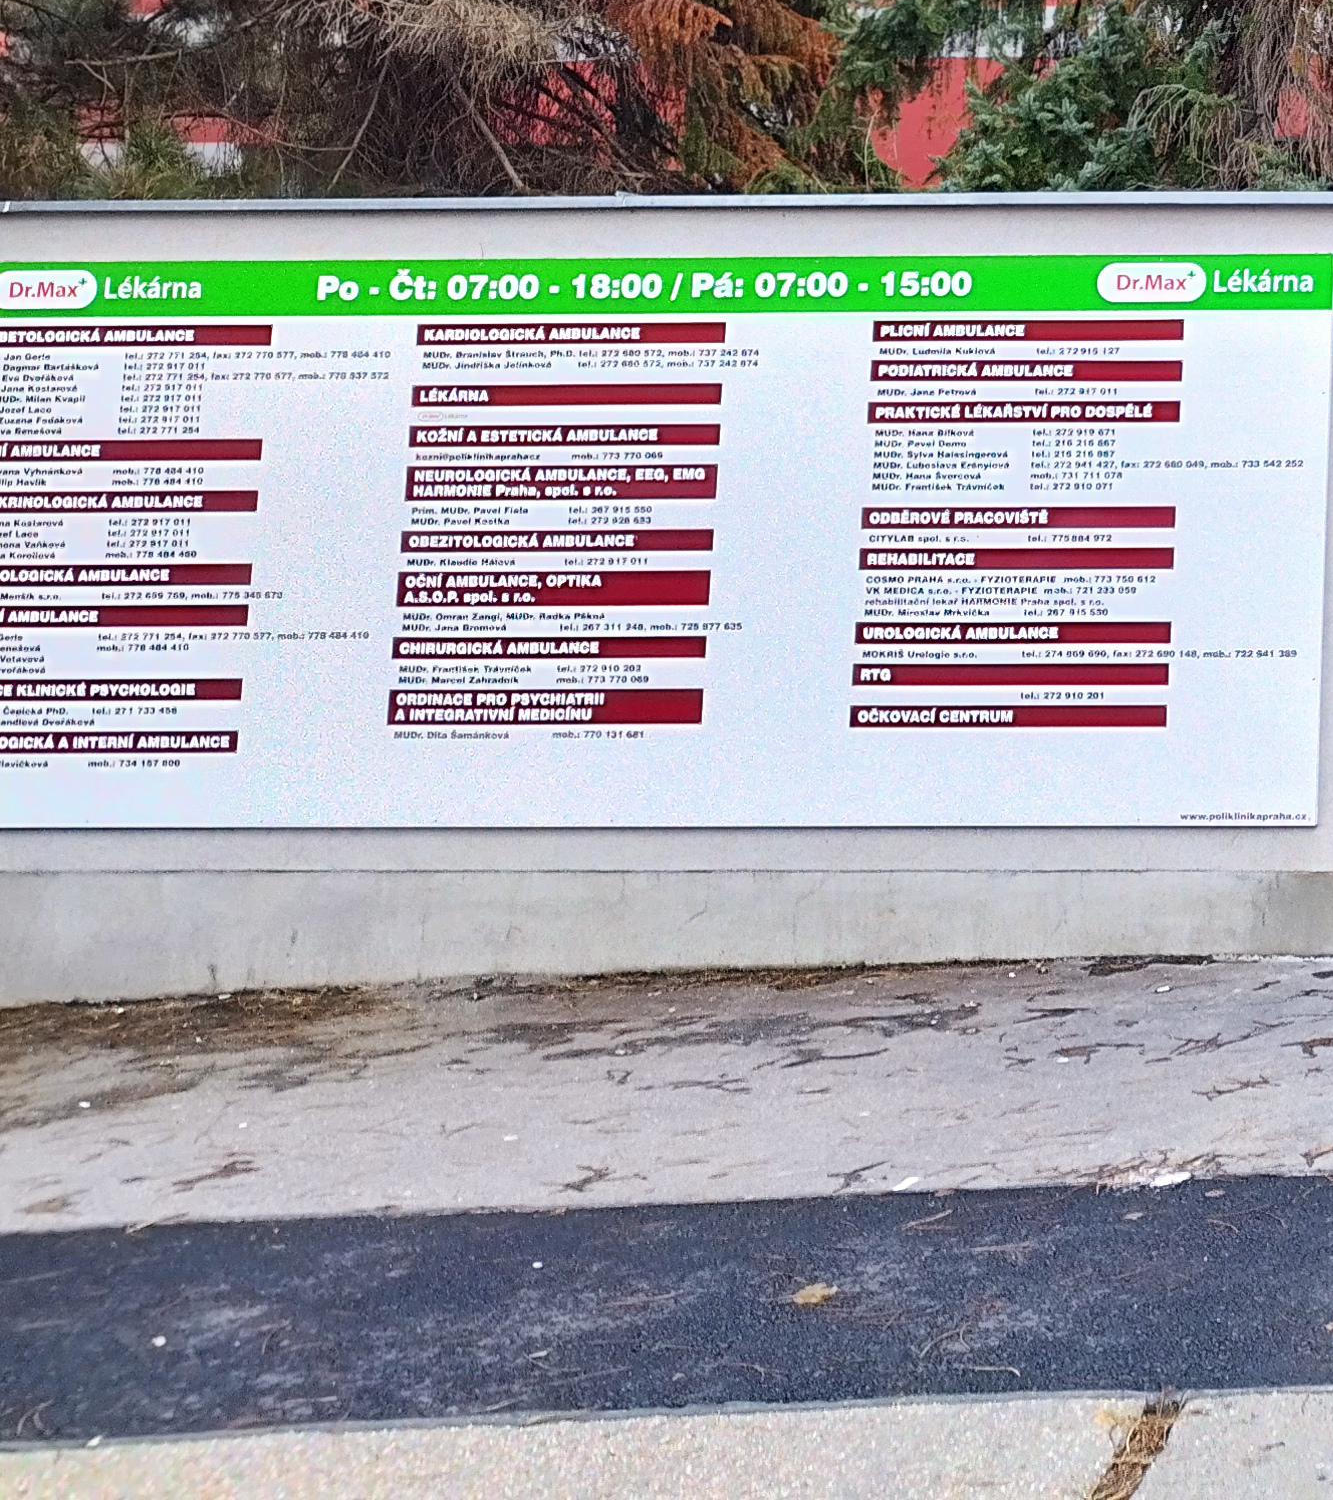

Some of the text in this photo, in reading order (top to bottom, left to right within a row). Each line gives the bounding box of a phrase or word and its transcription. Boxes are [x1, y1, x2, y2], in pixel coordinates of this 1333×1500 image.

[104, 277, 201, 300] Lékárna
[317, 275, 359, 301] Po
[389, 269, 436, 300] Čt:
[447, 274, 539, 300] 07:00
[571, 274, 662, 299] 18:00
[691, 273, 744, 299] Pá:
[755, 271, 848, 297] 07:00
[881, 271, 972, 297] 15:00
[1213, 269, 1315, 294] Lékárna
[104, 329, 195, 342] AMBULANCE
[424, 326, 640, 341] KARDIOLOGICKÁ AMBULANCE
[880, 323, 1025, 338] PLICNÍ AMBULANCE
[878, 362, 1075, 377] PODIATRICKÁ AMBULANCE
[420, 387, 489, 403] LÉKÁRNA
[875, 402, 1153, 420] PRAKTICKÉ LÉKAŘSTVÍ PRO DOSPĚLÉ
[416, 427, 658, 443] KOŽNÍ A ESTETICKÁ AMBULANCE
[11, 444, 101, 457] AMBULANCE
[414, 467, 705, 483] NEUROLOGICKÁ AMBULANCE, EEG, EMG
[413, 484, 492, 497] HARMONIE
[112, 496, 203, 508] AMBULANCE
[869, 509, 1049, 525] ODBĚROVÉ PRACOVIŠTĚ
[409, 533, 635, 549] OBEZITOLOGICKÁ AMBULANCE
[867, 553, 976, 566] REHABILITACE
[78, 569, 170, 582] AMBULANCE
[405, 573, 602, 589] OČNÍ AMBULANCE, OPTIKA
[8, 610, 99, 623] AMBULANCE
[863, 625, 1059, 640] UROLOGICKÁ AMBULANCE
[399, 640, 599, 655] CHIRURGICKÁ AMBULANCE
[860, 668, 892, 682] RTG
[17, 682, 196, 697] KLINICKÉ PSYCHOLOGIE
[396, 693, 605, 706] ORDINACE PRO PSYCHIATRII
[394, 706, 593, 721] A INTEGRATIVNÍ MEDICÍNU
[857, 708, 1013, 724] OČKOVACÍ CENTRUM
[58, 736, 69, 749] A
[73, 734, 134, 749] INTERNÍ
[137, 736, 229, 748] AMBULANCE
[1180, 812, 1307, 821] www.poliklinikapraha.cz
